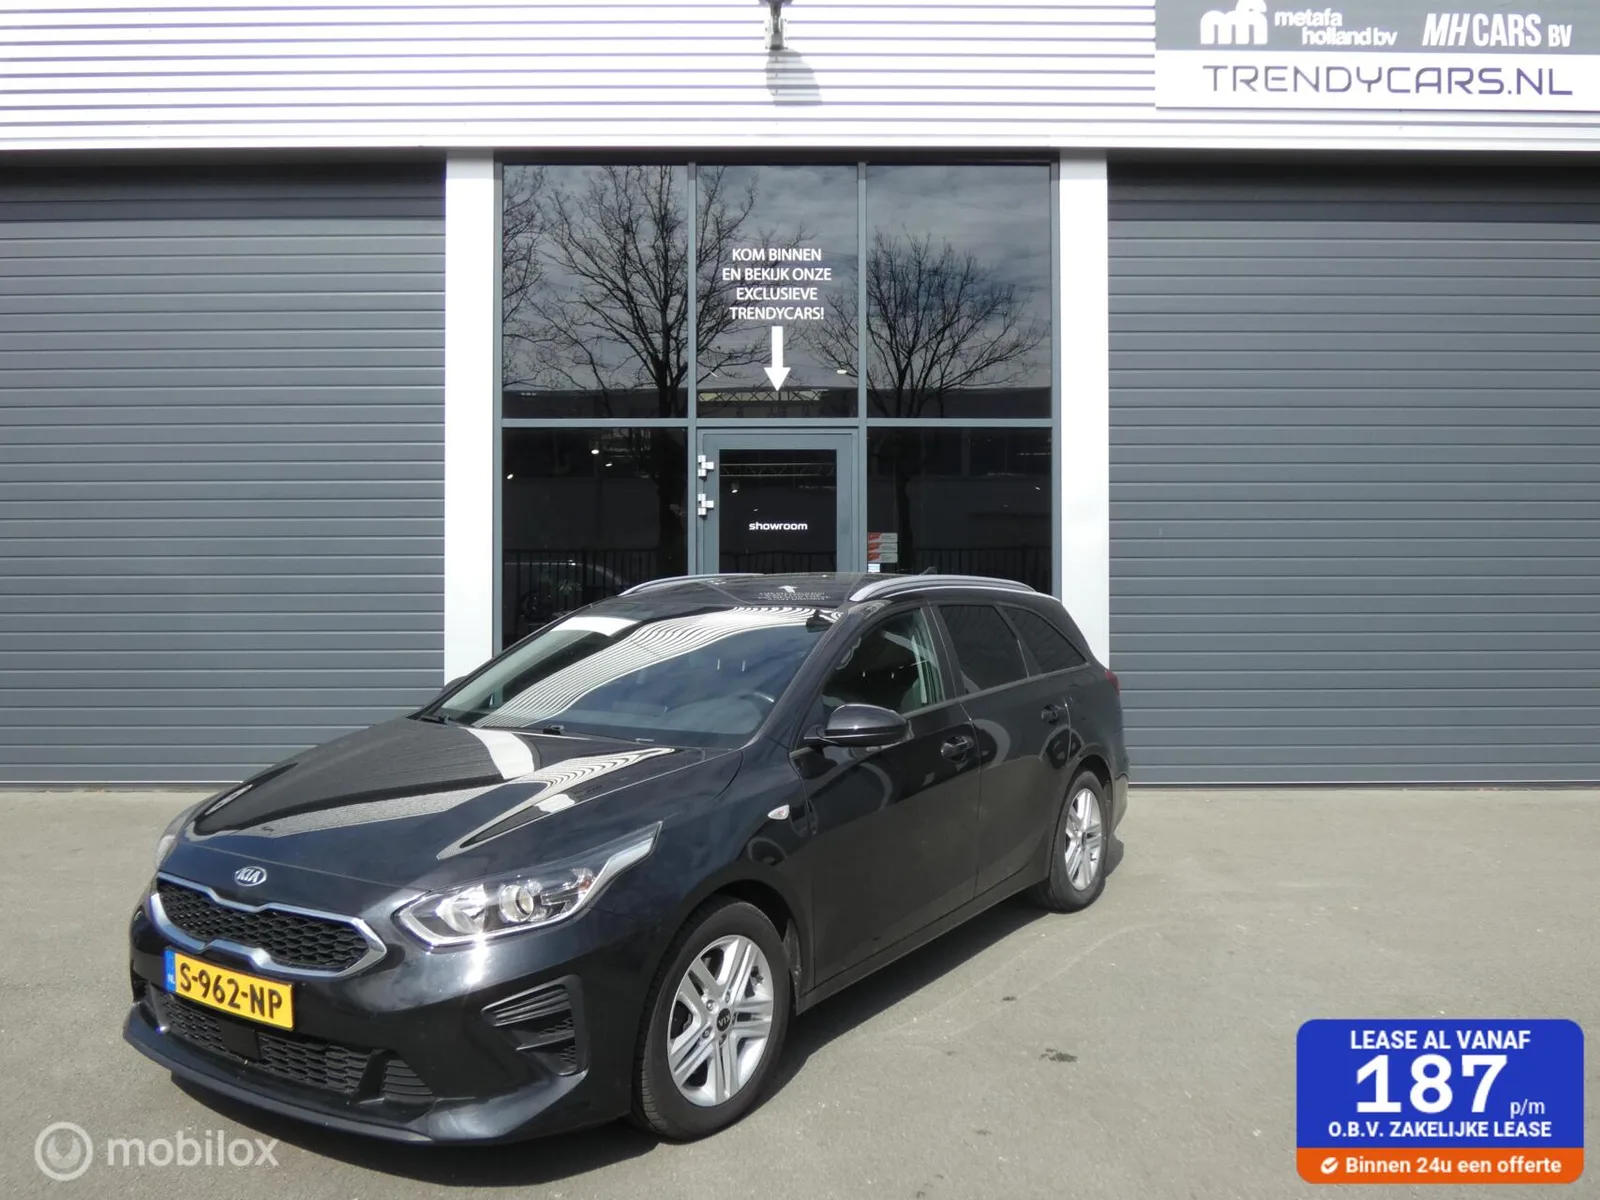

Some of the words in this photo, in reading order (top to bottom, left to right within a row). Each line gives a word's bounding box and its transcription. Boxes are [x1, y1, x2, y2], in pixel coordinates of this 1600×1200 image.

[1274, 8, 1342, 27] metafa
[1302, 27, 1371, 46] holland
[1373, 28, 1398, 46] bv
[1548, 24, 1573, 48] BV
[1203, 65, 1573, 96] TRENDYCARS.NL
[732, 248, 765, 261] KOM
[769, 248, 822, 261] BINNEN
[722, 267, 741, 281] EN
[744, 267, 789, 281] BEKIJK
[792, 267, 832, 281] ONZE
[736, 287, 818, 300] EXCLUSIEVE
[729, 307, 824, 320] TRENDYCARS!
[749, 521, 808, 531] showroom
[236, 868, 261, 883] KIA
[180, 962, 283, 1020] S-962-NP
